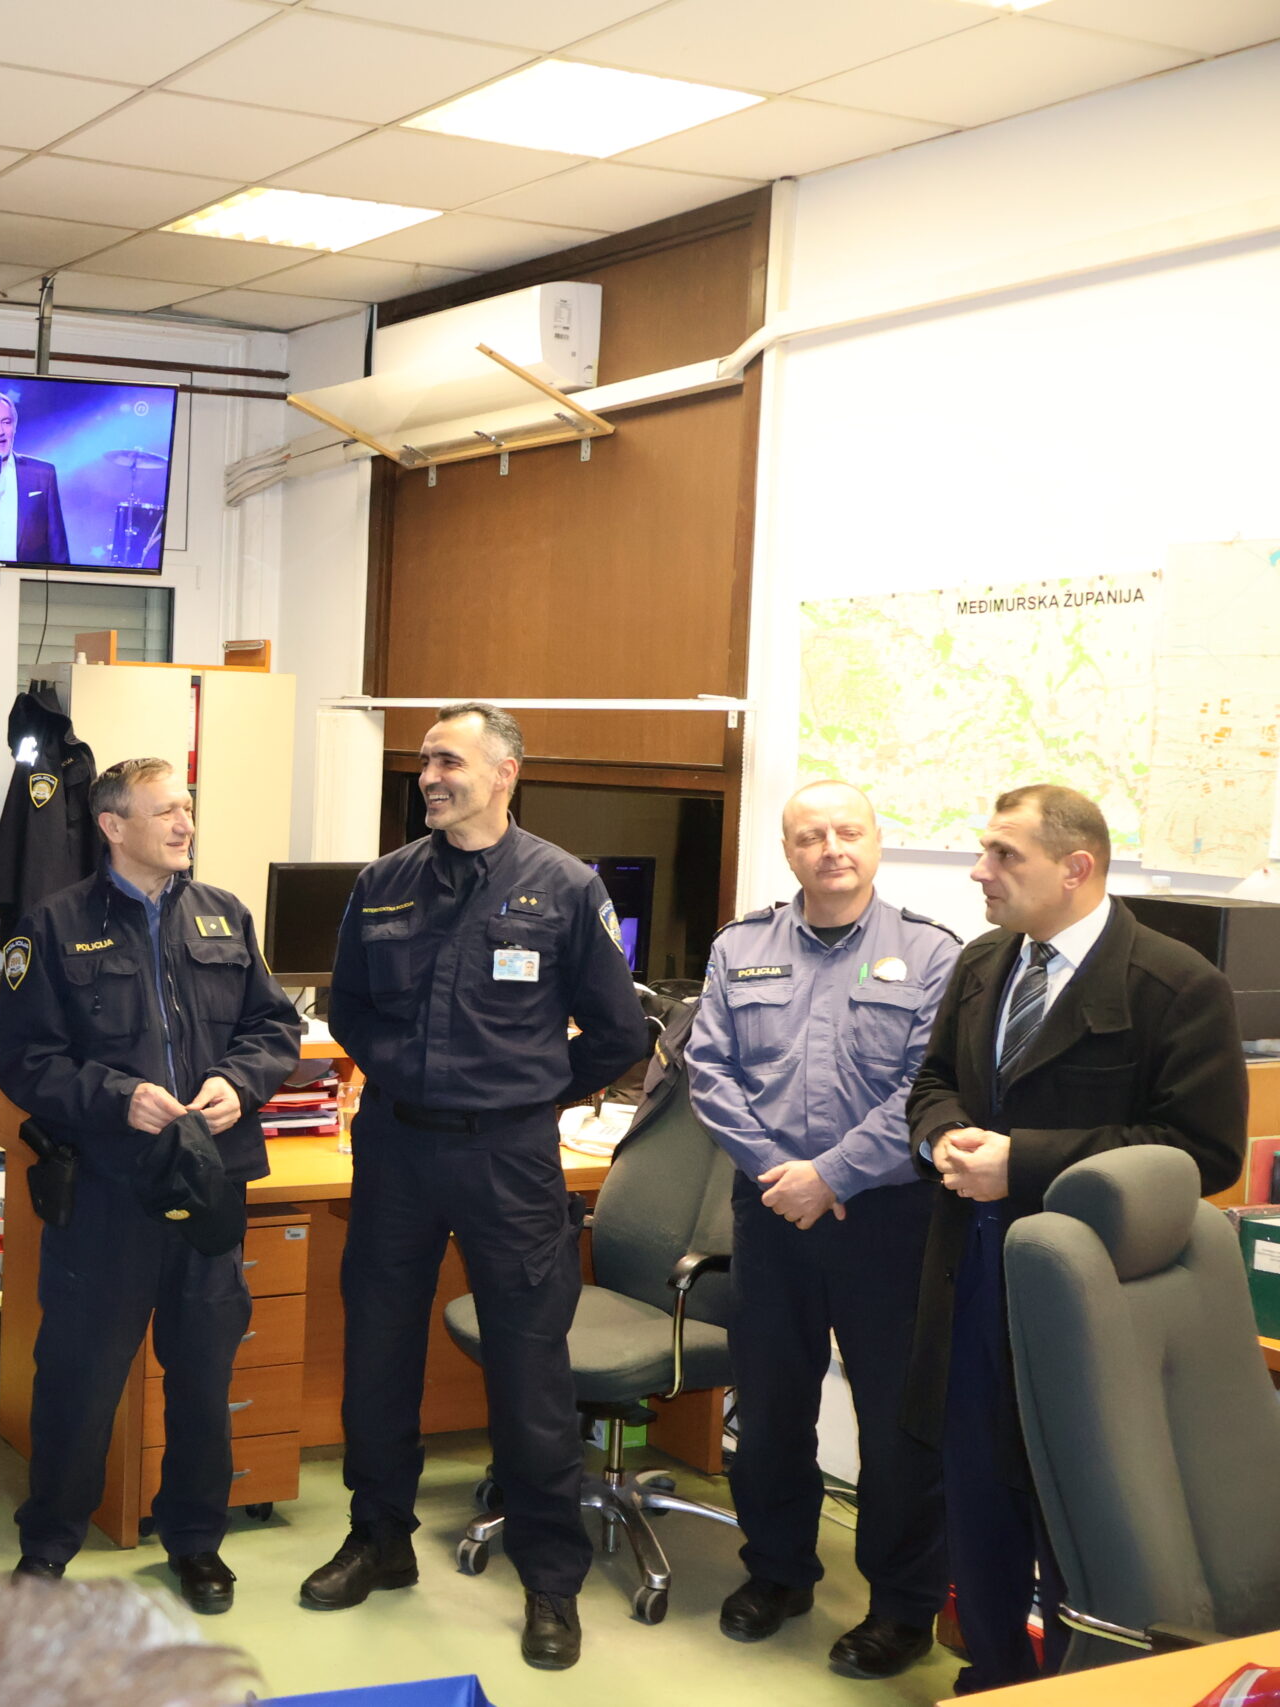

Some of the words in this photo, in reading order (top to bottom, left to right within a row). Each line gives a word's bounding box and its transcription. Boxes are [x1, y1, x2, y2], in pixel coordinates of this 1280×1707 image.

[957, 594, 1059, 616] MEĐIMURSKA
[1063, 588, 1145, 608] ŽUPANIJA
[75, 938, 114, 952] POLICIJA
[738, 967, 782, 978] POLICIJA
